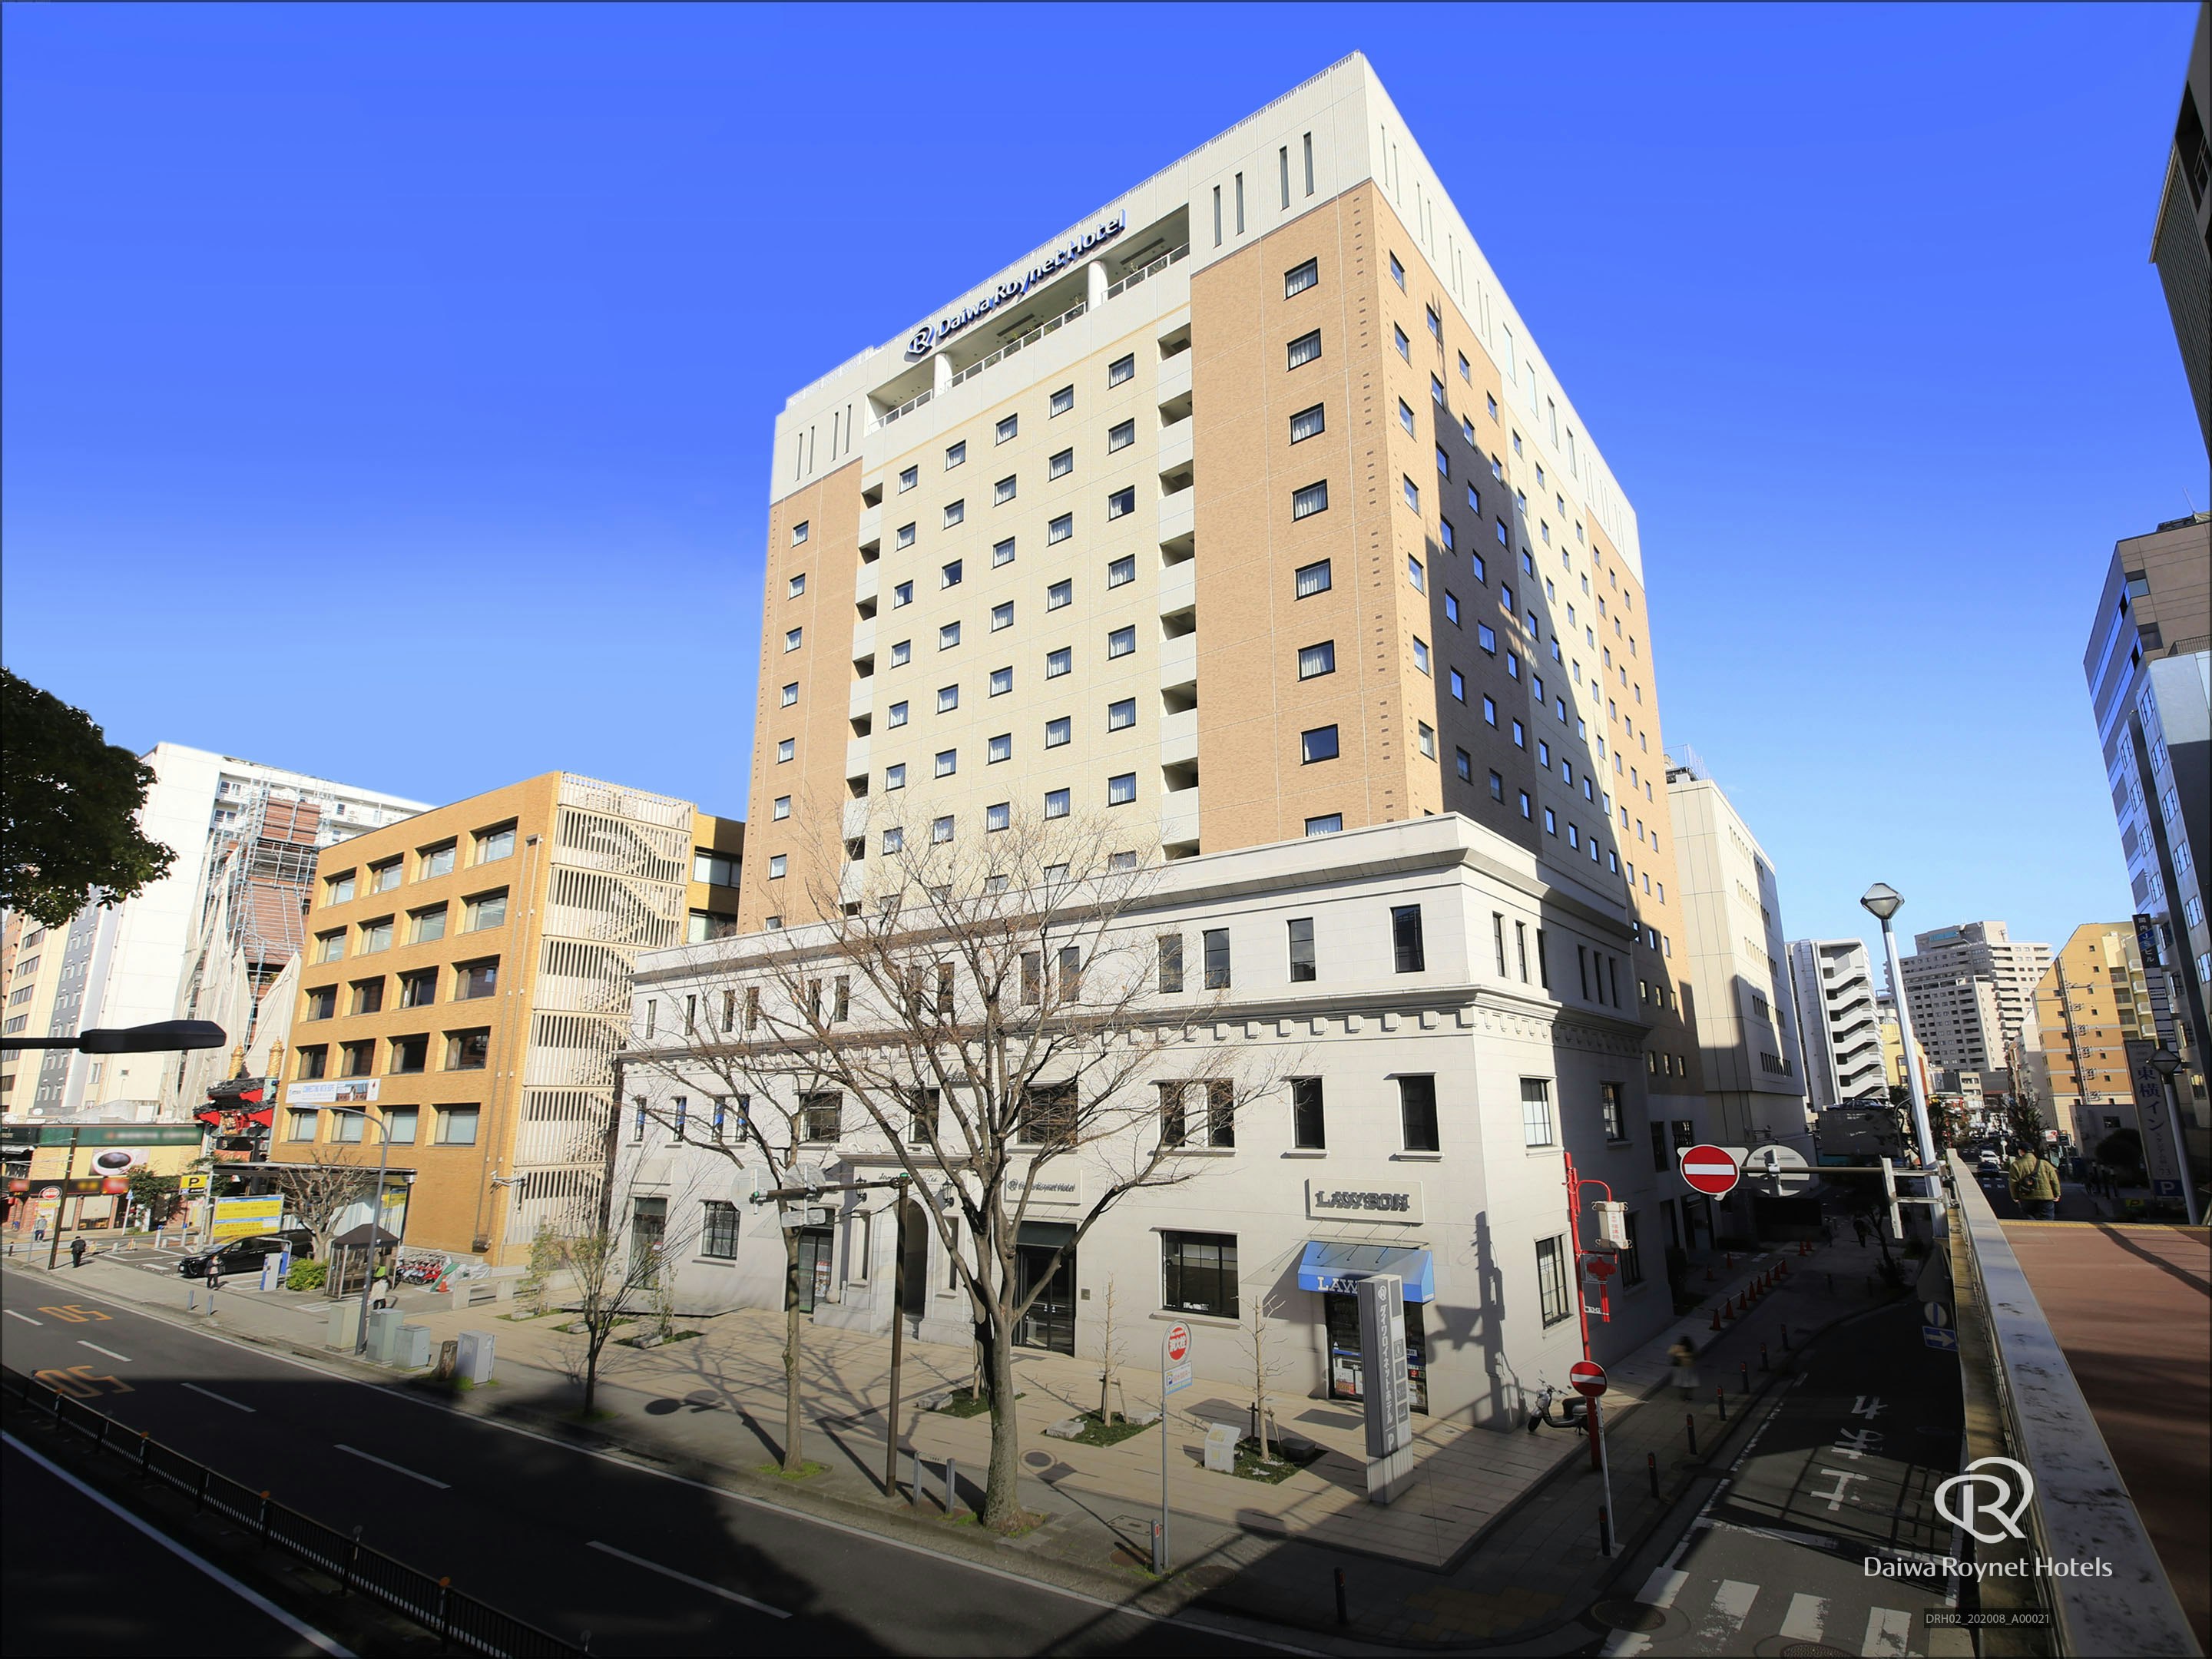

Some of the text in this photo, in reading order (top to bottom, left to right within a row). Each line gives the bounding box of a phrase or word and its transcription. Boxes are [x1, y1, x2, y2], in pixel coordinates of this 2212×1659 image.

[938, 296, 993, 339] Daiwa
[994, 249, 1067, 306] Roynet
[1067, 209, 1126, 262] Hotel
[2137, 917, 2154, 962] 関内JSビル
[2137, 1066, 2164, 1131] 東横イン
[188, 1177, 200, 1187] P
[2160, 1181, 2176, 1195] P
[1315, 1190, 1410, 1211] LAWSON
[1379, 1305, 1394, 1426] ダイワロイネットホテル
[1387, 1432, 1395, 1452] P
